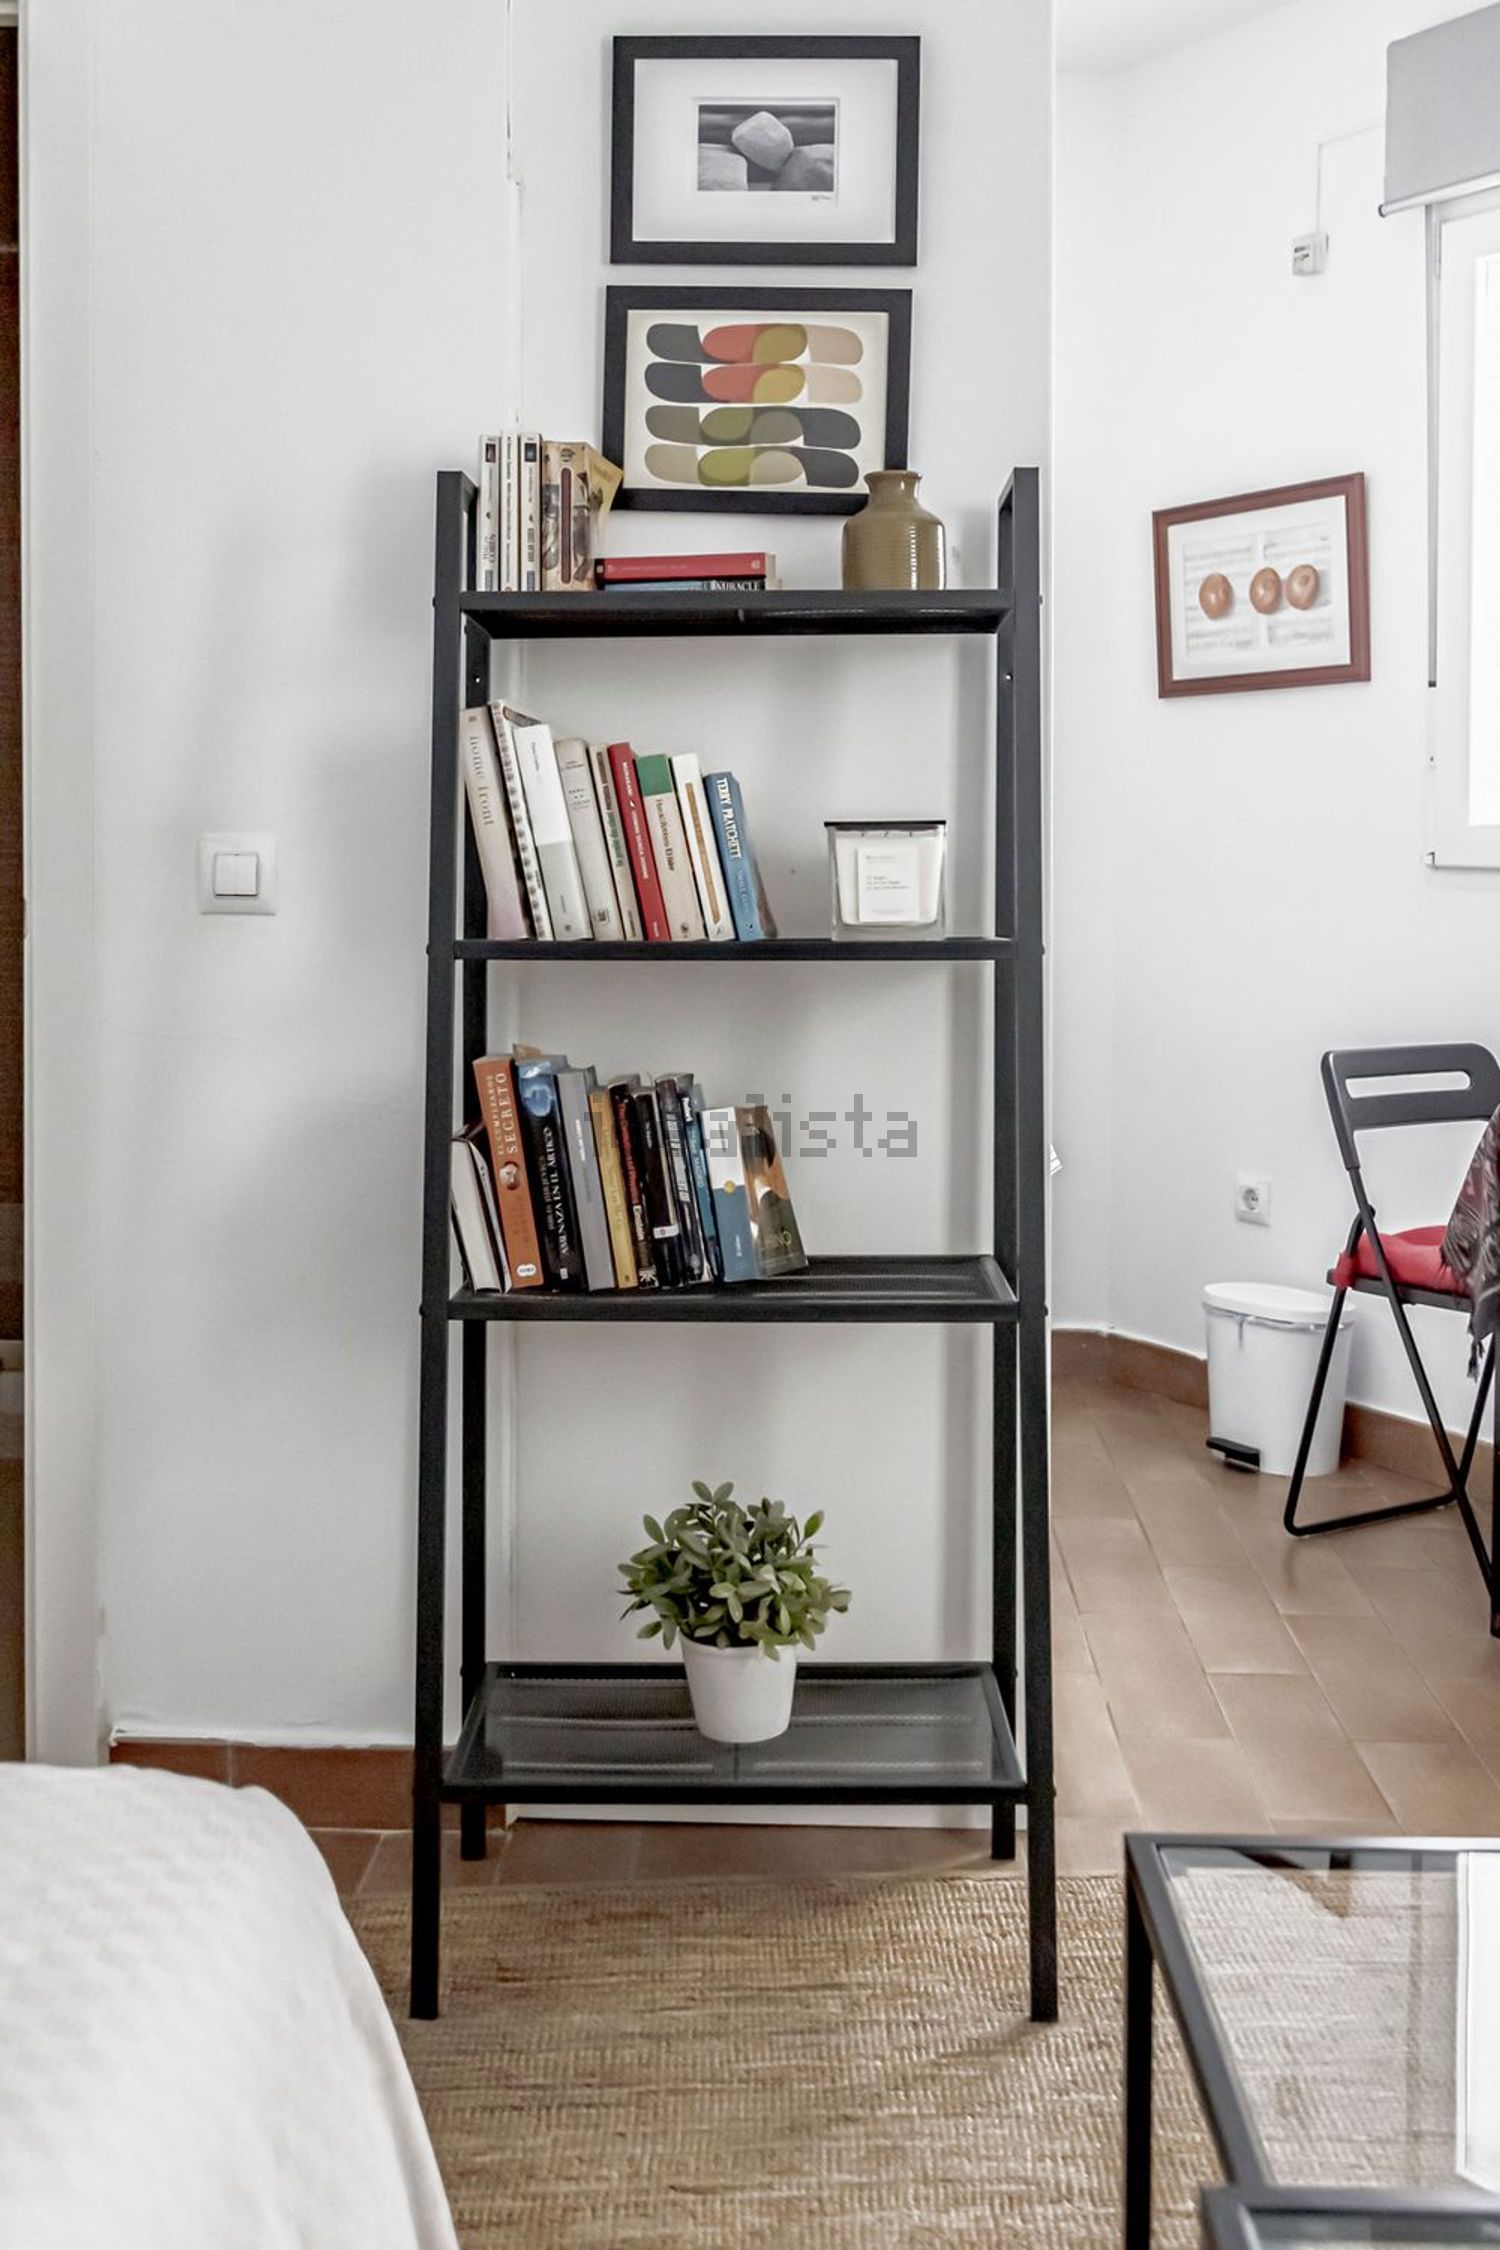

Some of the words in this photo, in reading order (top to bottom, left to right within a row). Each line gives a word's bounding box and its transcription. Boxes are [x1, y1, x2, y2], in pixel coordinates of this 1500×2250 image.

[716, 777, 732, 804] TERRY
[721, 808, 742, 859] PRATCHETT
[495, 1072, 519, 1155] SECRETO
[552, 1184, 561, 1200] EN
[555, 1202, 570, 1255] AMENAZA
[632, 1205, 645, 1241] Einstein
